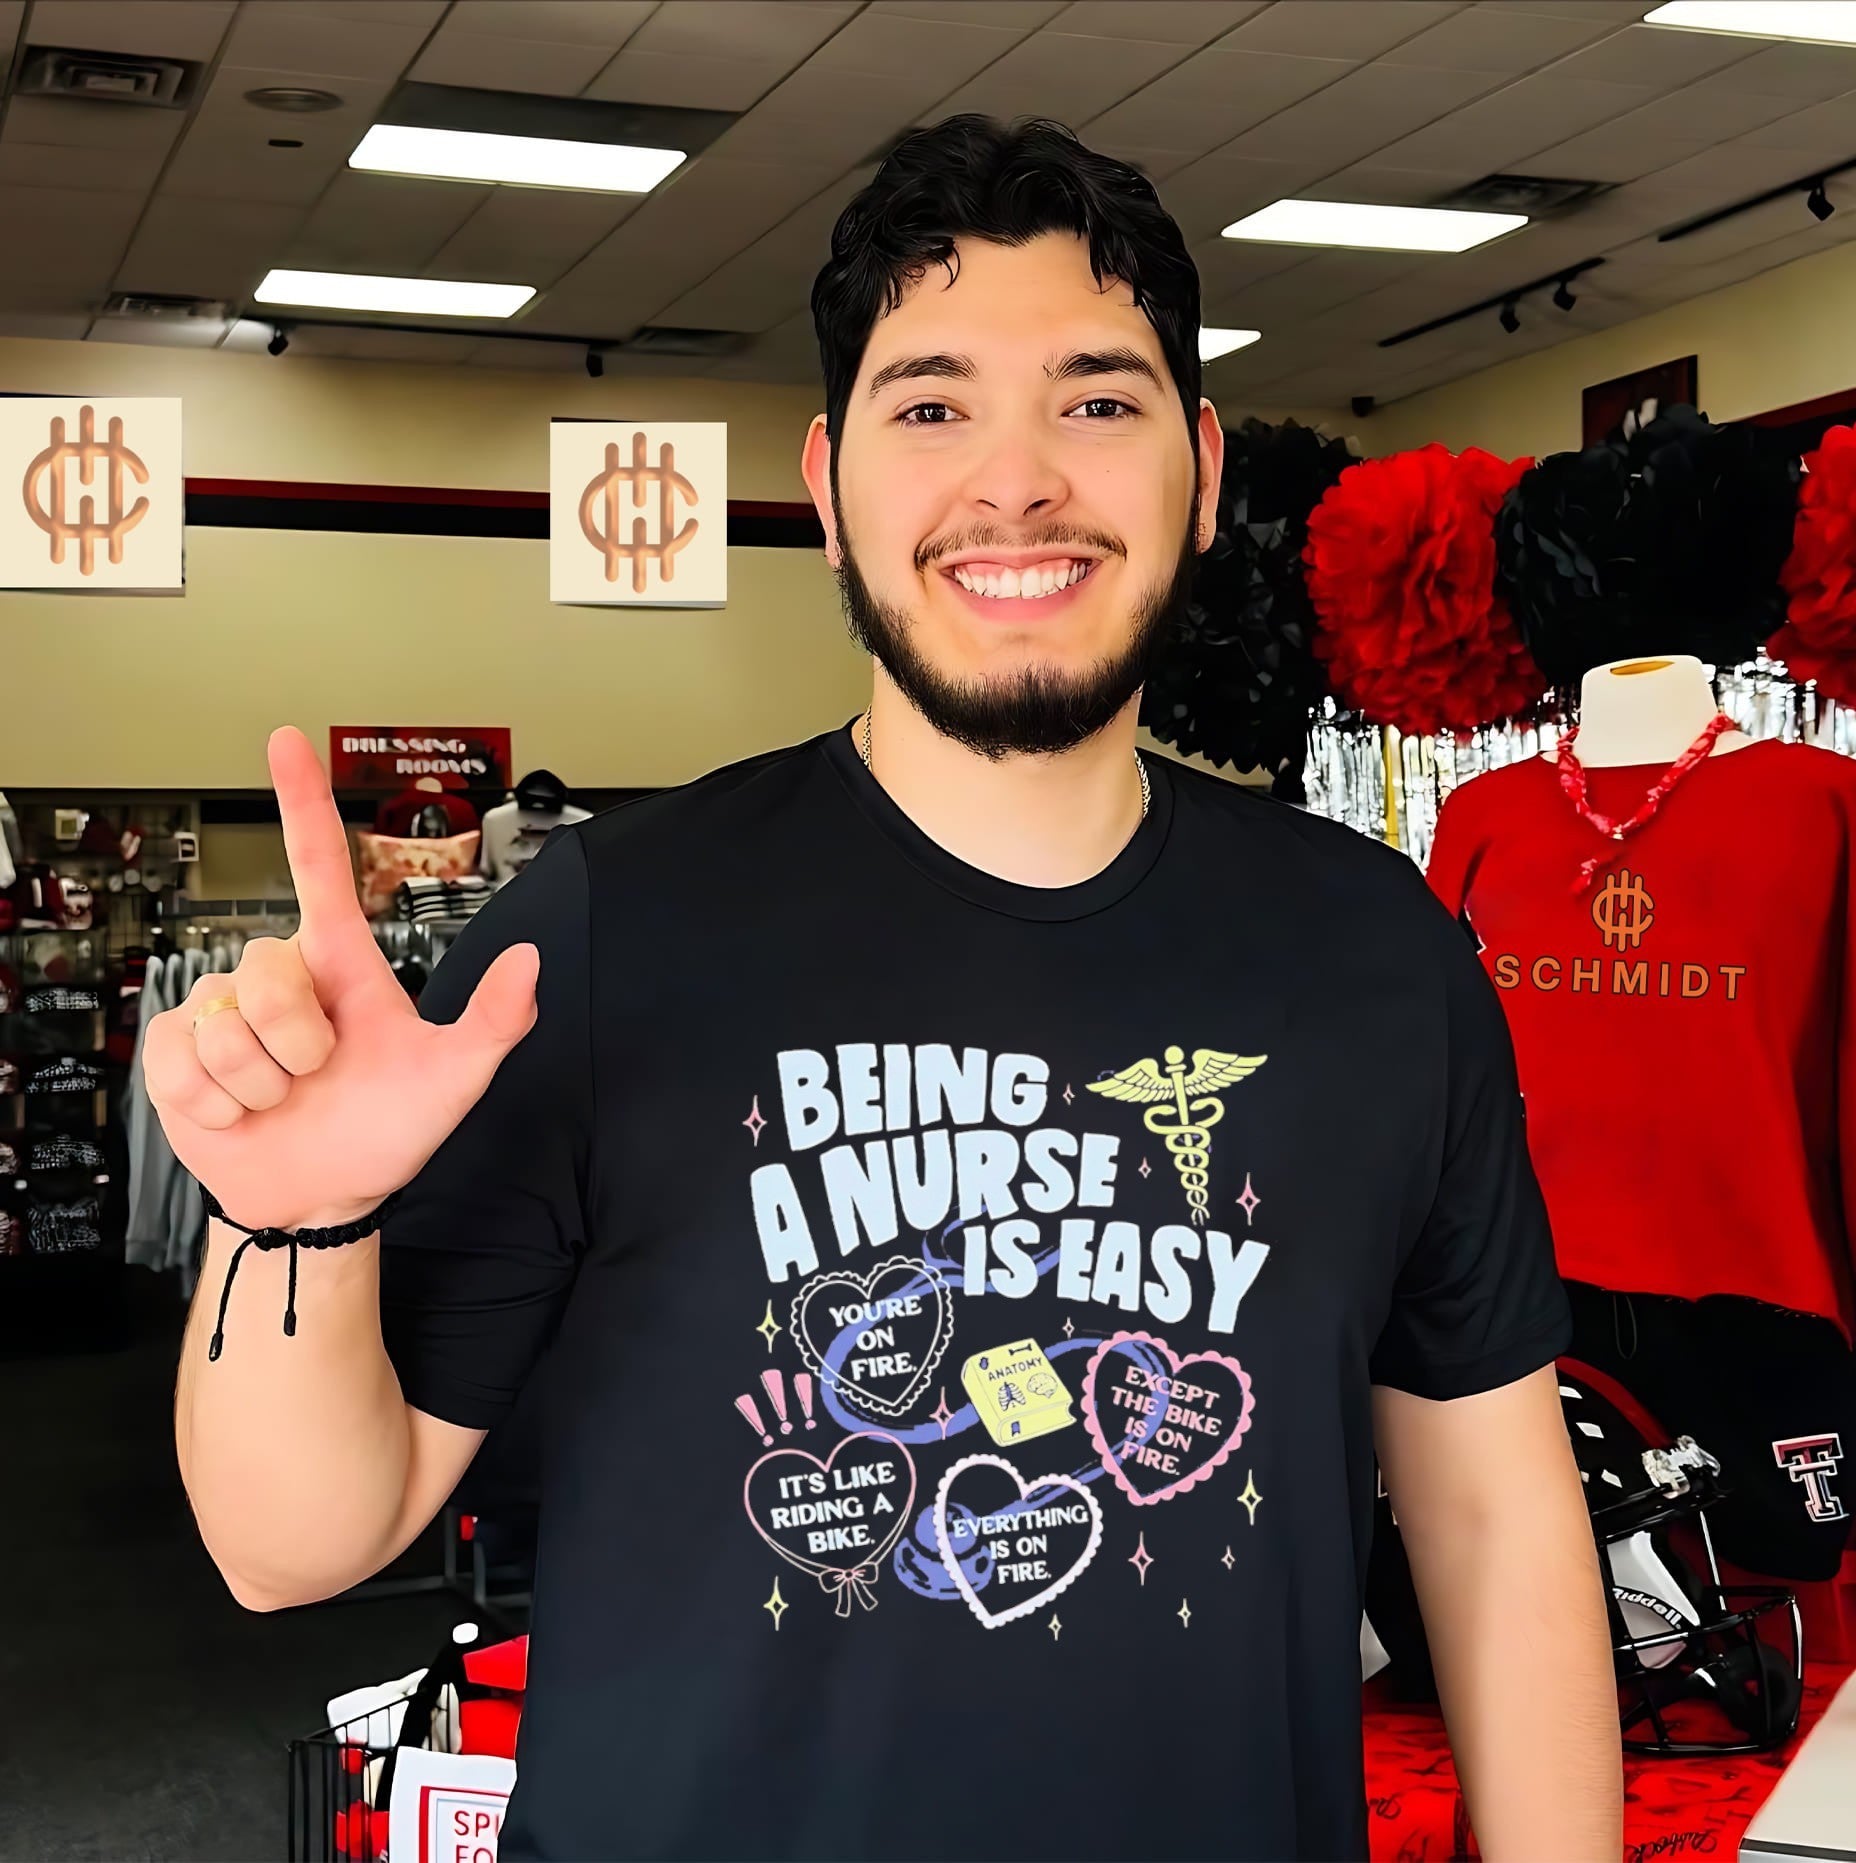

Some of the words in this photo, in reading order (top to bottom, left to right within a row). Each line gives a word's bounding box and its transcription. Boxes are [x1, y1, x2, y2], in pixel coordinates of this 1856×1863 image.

[342, 737, 467, 754] DRESSING
[396, 758, 487, 775] ROOMS
[1494, 954, 1747, 1000] SCHMIDT
[776, 1043, 1050, 1151] BEING
[750, 1163, 819, 1283] A
[820, 1128, 1120, 1257] NURSE
[963, 1218, 1041, 1299] IS
[1057, 1218, 1271, 1333] EASY
[828, 1294, 923, 1328] YOU'RE
[856, 1325, 895, 1351] ON
[851, 1351, 918, 1382] FIRE.
[988, 1357, 1043, 1382] ANATOMY
[1124, 1365, 1221, 1410] EXCEPT
[1111, 1386, 1160, 1416] THE
[1164, 1403, 1223, 1437] BIKE
[1124, 1416, 1149, 1439] IS
[1155, 1427, 1193, 1453] ON
[1120, 1440, 1181, 1476] FIRE.
[779, 1472, 827, 1499] IT'S
[833, 1461, 897, 1491] LIKE
[770, 1496, 865, 1530] RIDING
[873, 1492, 894, 1515] A
[952, 1505, 1090, 1539] EVERYTHING
[807, 1524, 876, 1554] BIKE.
[989, 1539, 1011, 1560] IS
[1015, 1534, 1048, 1557] ON
[997, 1560, 1052, 1585] FIRE.
